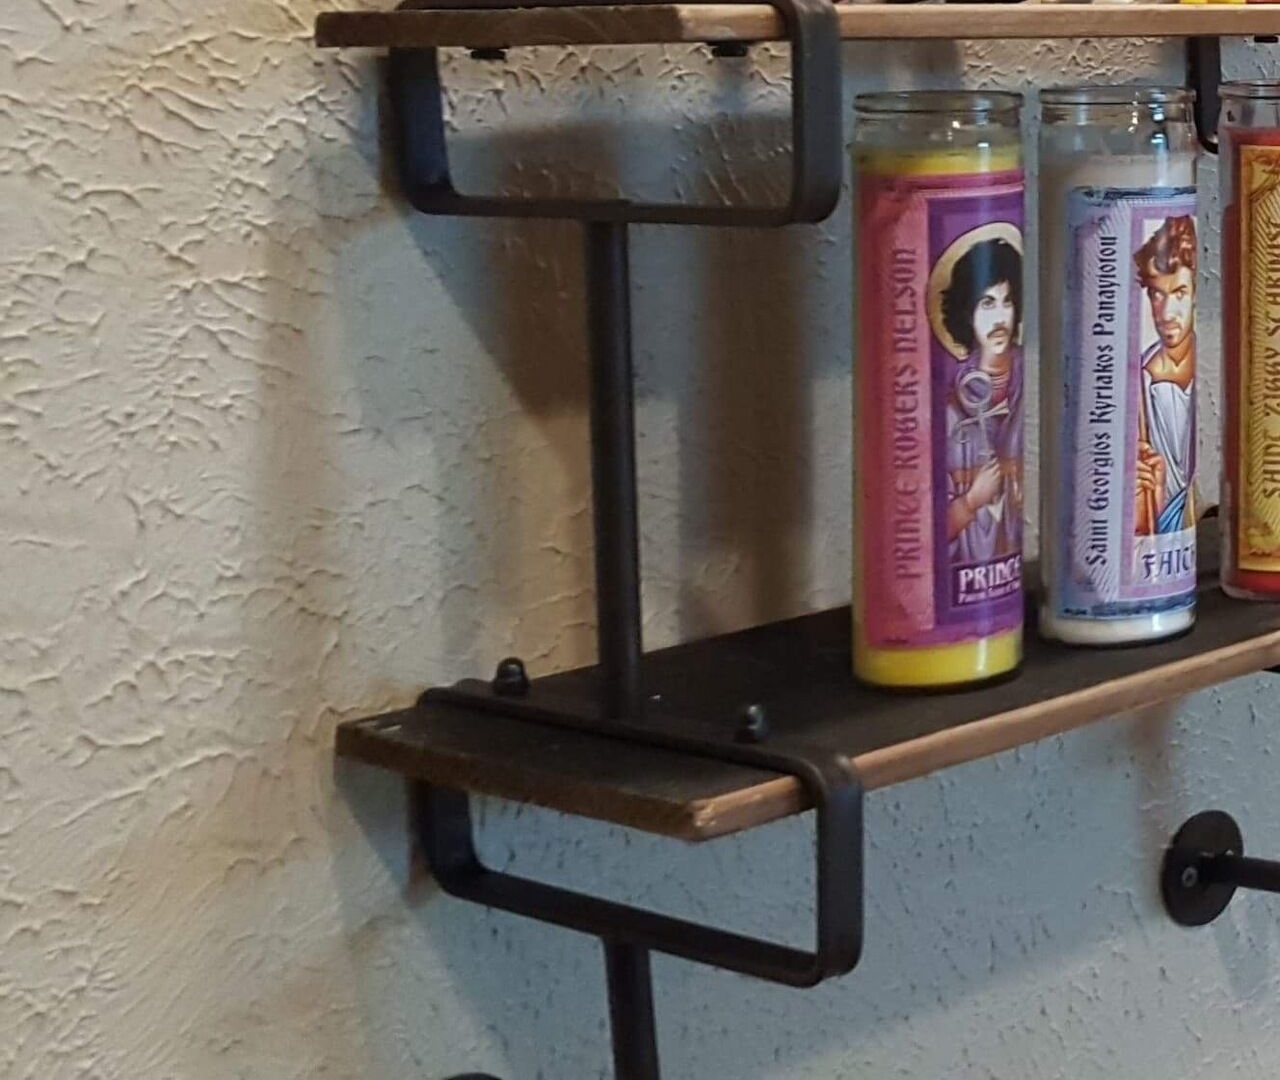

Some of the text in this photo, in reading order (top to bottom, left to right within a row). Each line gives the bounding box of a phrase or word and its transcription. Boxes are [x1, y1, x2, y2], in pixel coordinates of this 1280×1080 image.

[892, 248, 922, 580] PRINCE ROGERS NELSON
[1084, 235, 1120, 567] Saint Georgios Kyriakos Panayiotou
